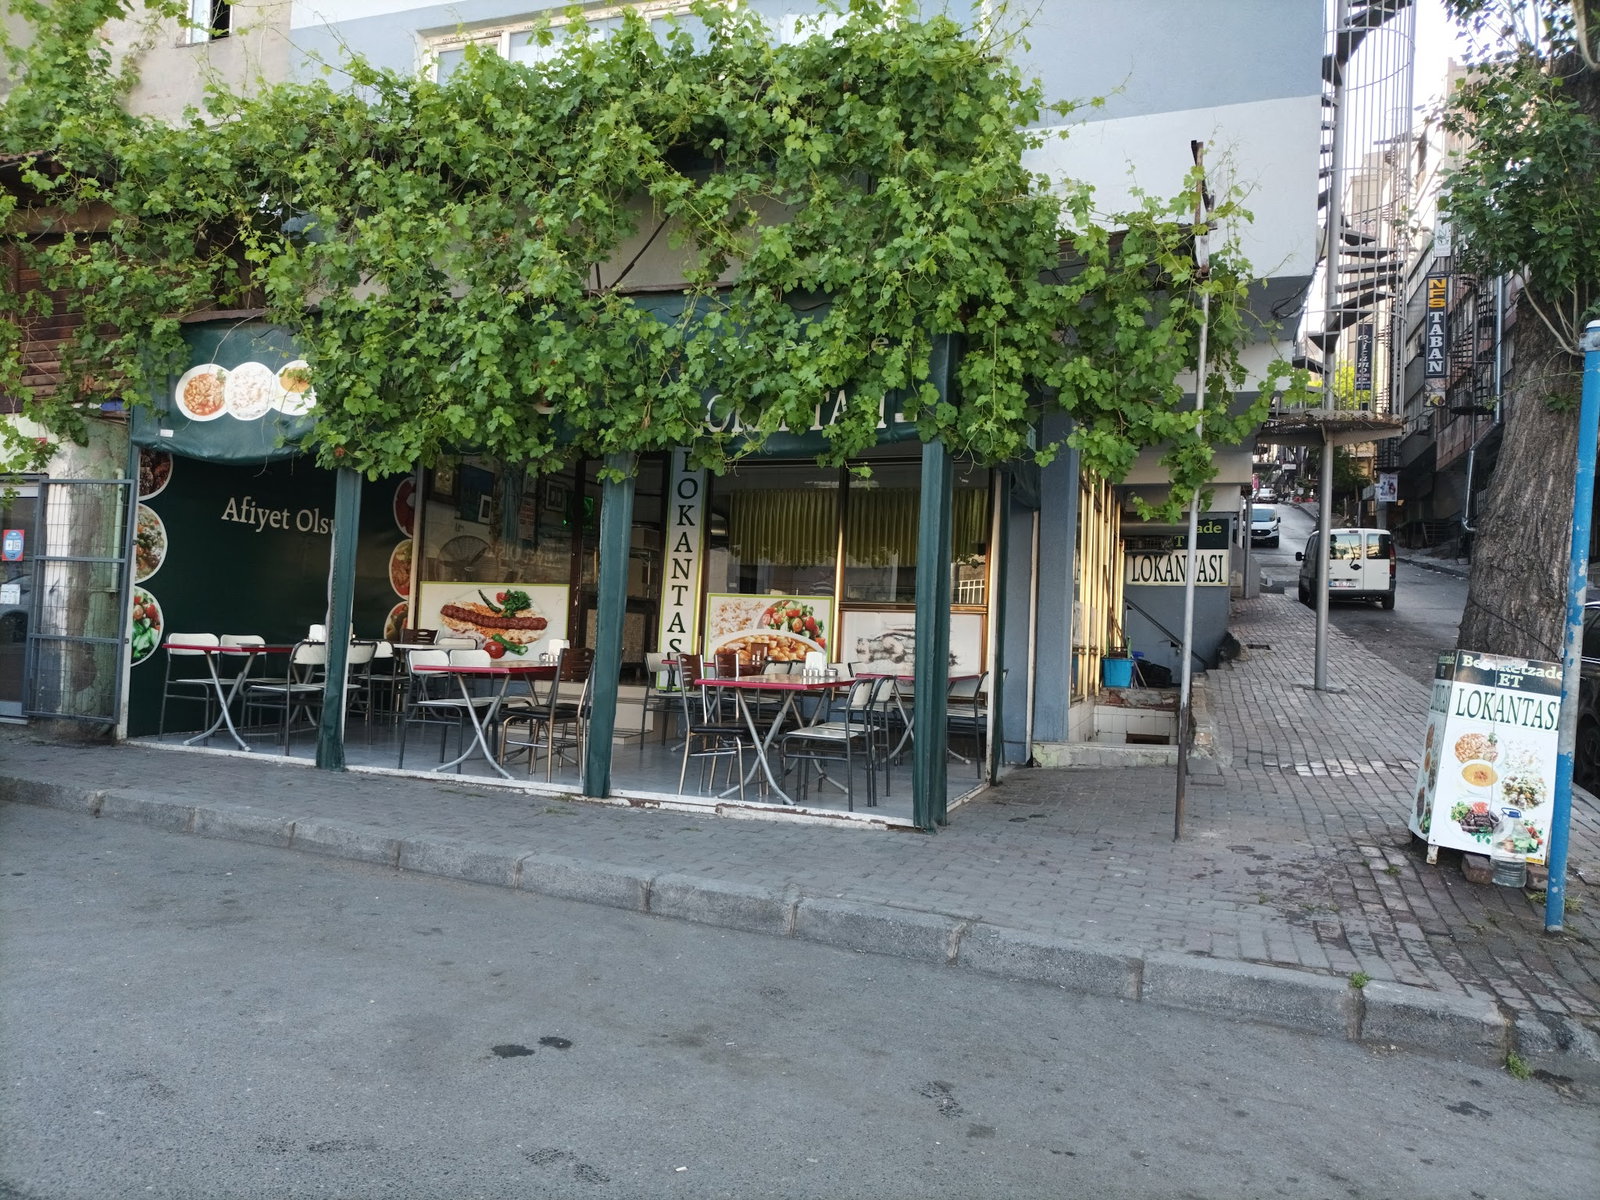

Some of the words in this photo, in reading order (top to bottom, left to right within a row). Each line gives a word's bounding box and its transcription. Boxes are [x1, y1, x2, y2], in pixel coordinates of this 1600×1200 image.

[1428, 278, 1447, 308] NFS
[1428, 311, 1444, 372] TABAN
[221, 496, 290, 532] Afiyet
[1132, 555, 1223, 582] LOKANASI
[1498, 673, 1524, 688] ET
